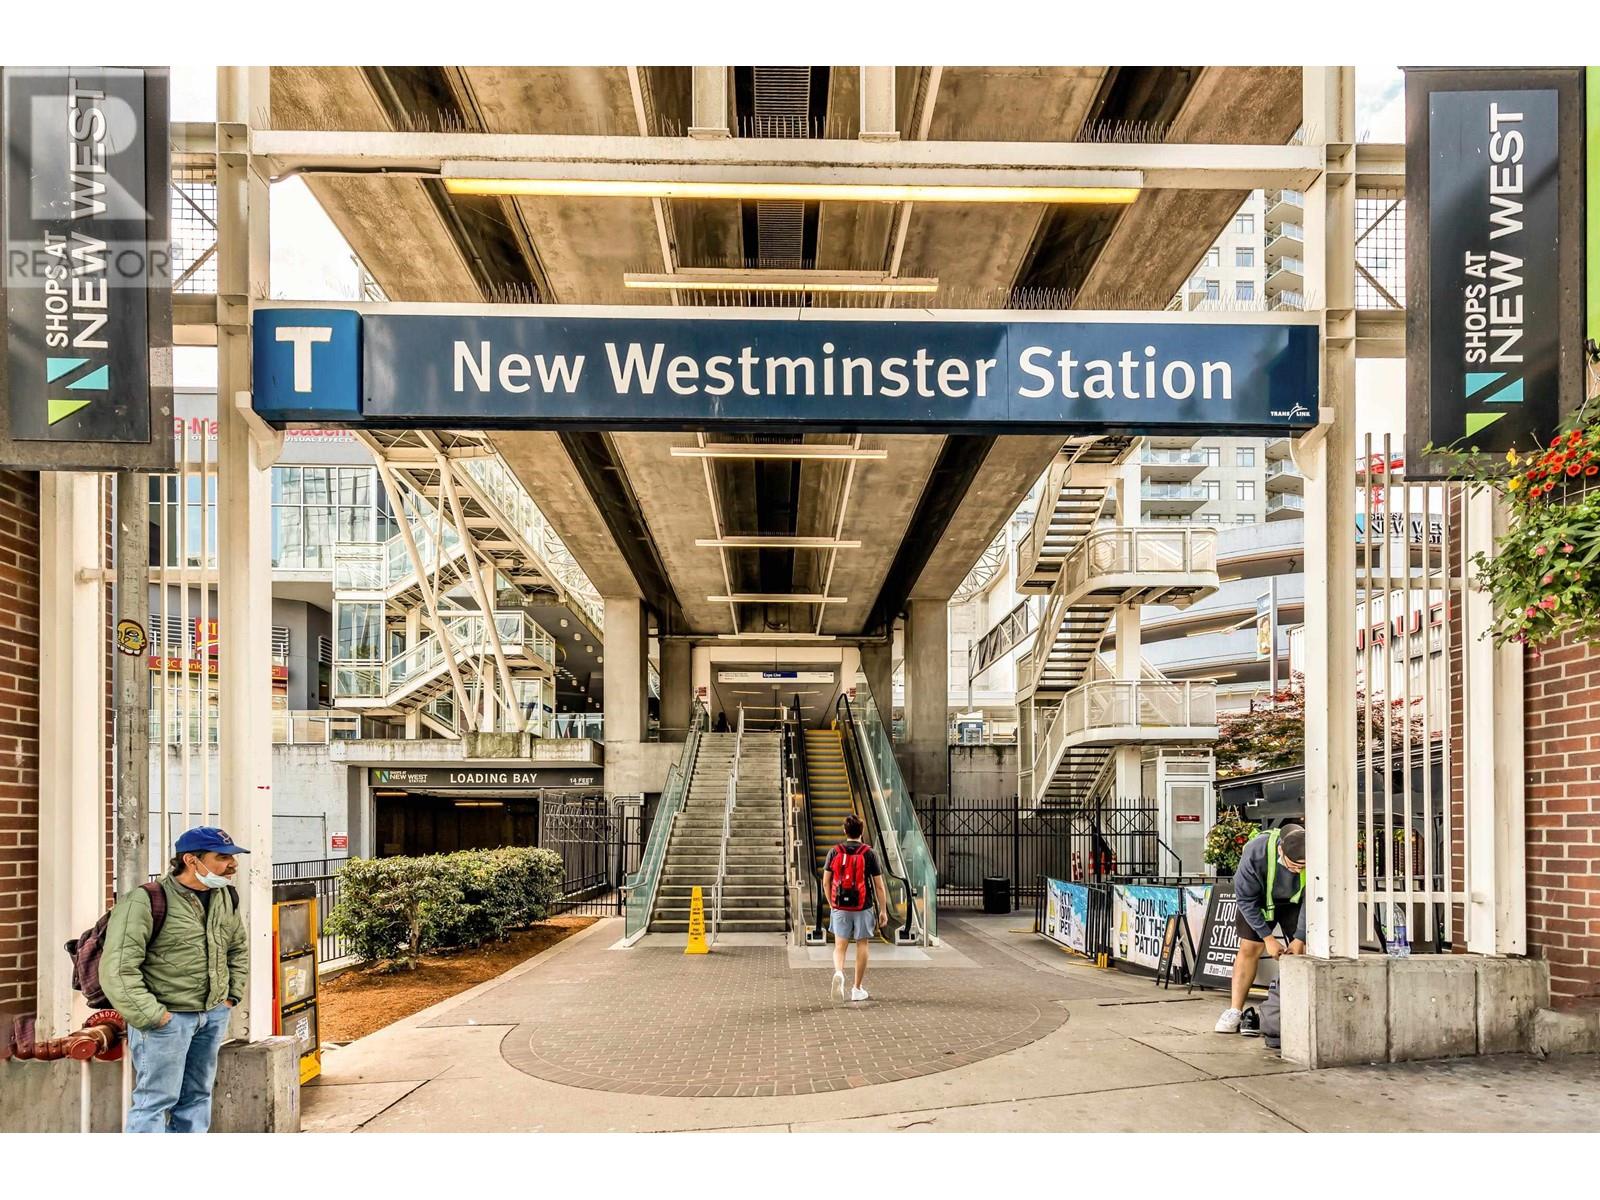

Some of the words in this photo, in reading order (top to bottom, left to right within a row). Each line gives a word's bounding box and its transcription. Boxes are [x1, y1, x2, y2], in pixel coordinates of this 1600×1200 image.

[68, 77, 107, 219] WEST
[1489, 102, 1524, 240] WEST
[44, 229, 67, 261] AT
[1465, 250, 1487, 278] AT
[45, 264, 69, 348] SHOPS
[71, 230, 109, 349] NEW
[1489, 250, 1524, 363] NEW
[1465, 278, 1487, 364] SHOPS
[275, 326, 333, 393] T
[453, 340, 586, 394] New
[604, 341, 997, 398] Westminster
[1017, 345, 1232, 400] Station
[155, 658, 178, 669] CBC
[450, 773, 508, 784] LOADING
[512, 773, 538, 784] BAY
[1134, 916, 1146, 935] ON
[1148, 918, 1166, 939] THE
[1135, 897, 1156, 917] JOIN
[1158, 899, 1168, 919] US
[1214, 902, 1238, 926] LIQU
[1134, 934, 1160, 957] PATIO
